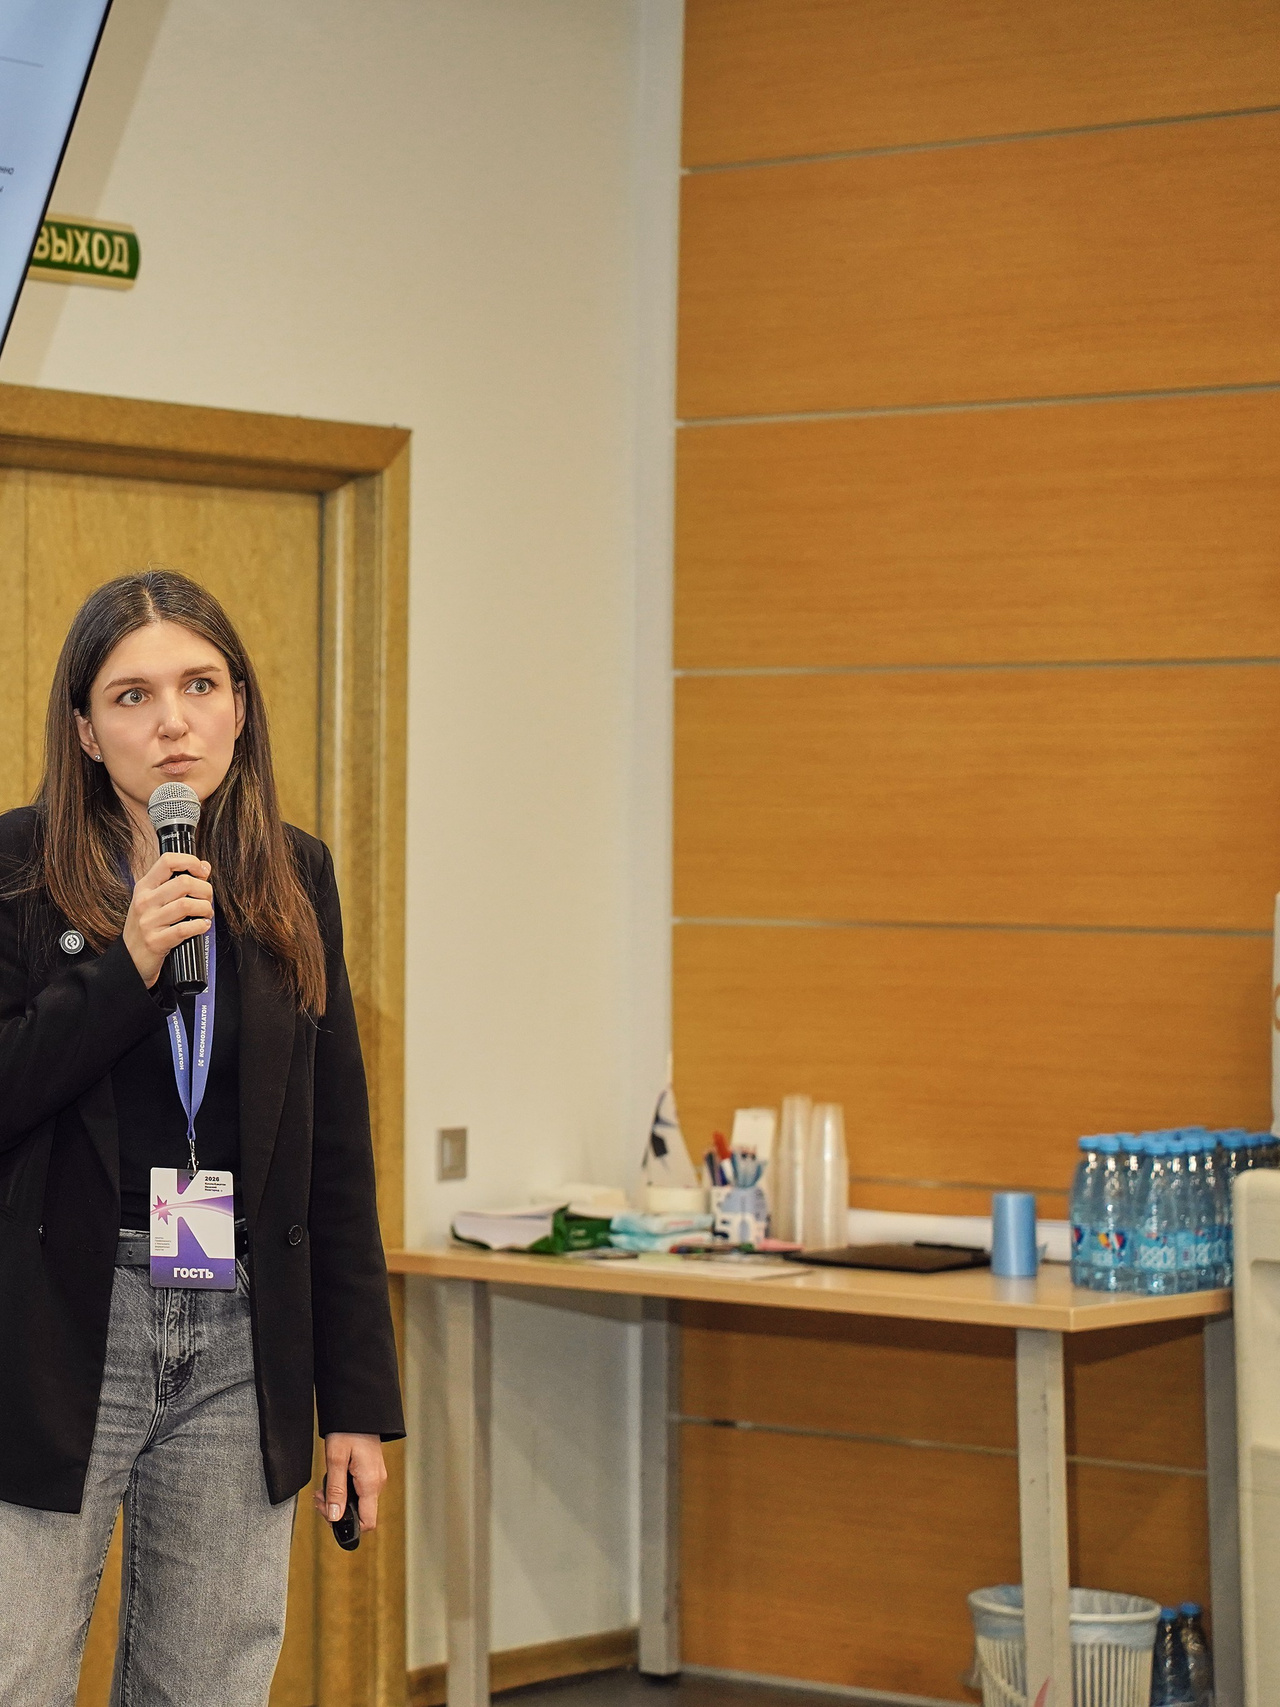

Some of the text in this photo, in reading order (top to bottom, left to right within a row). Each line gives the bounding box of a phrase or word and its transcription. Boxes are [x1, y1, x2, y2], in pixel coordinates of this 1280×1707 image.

[32, 225, 130, 274] ВЫХОД
[172, 1016, 184, 1070] КОСМОХАКАТОН
[199, 1004, 207, 1058] КОСМОХАКАТОН
[173, 1267, 214, 1279] ГОСТЬ
